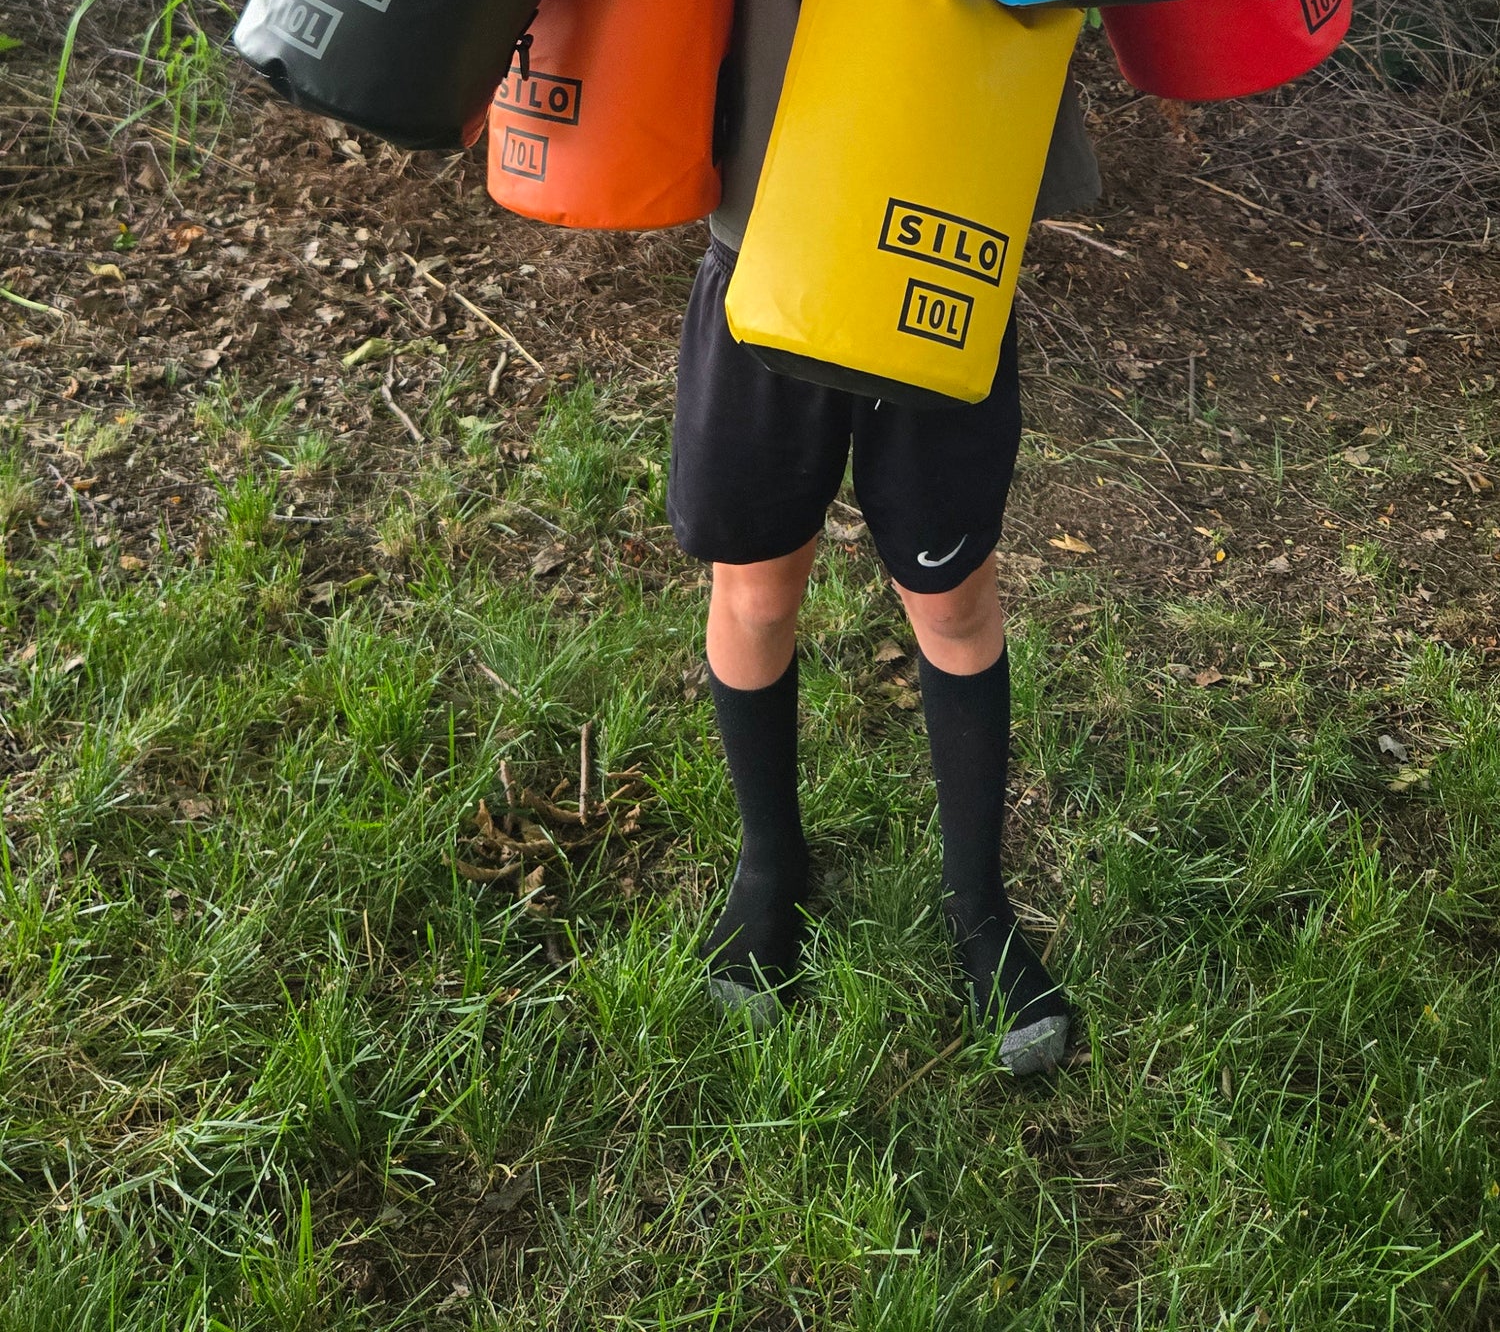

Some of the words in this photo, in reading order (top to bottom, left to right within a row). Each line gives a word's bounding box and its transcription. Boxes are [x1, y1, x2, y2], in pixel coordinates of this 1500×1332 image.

[510, 138, 537, 170] 10L
[897, 214, 998, 271] SILO
[916, 294, 958, 335] 10L
